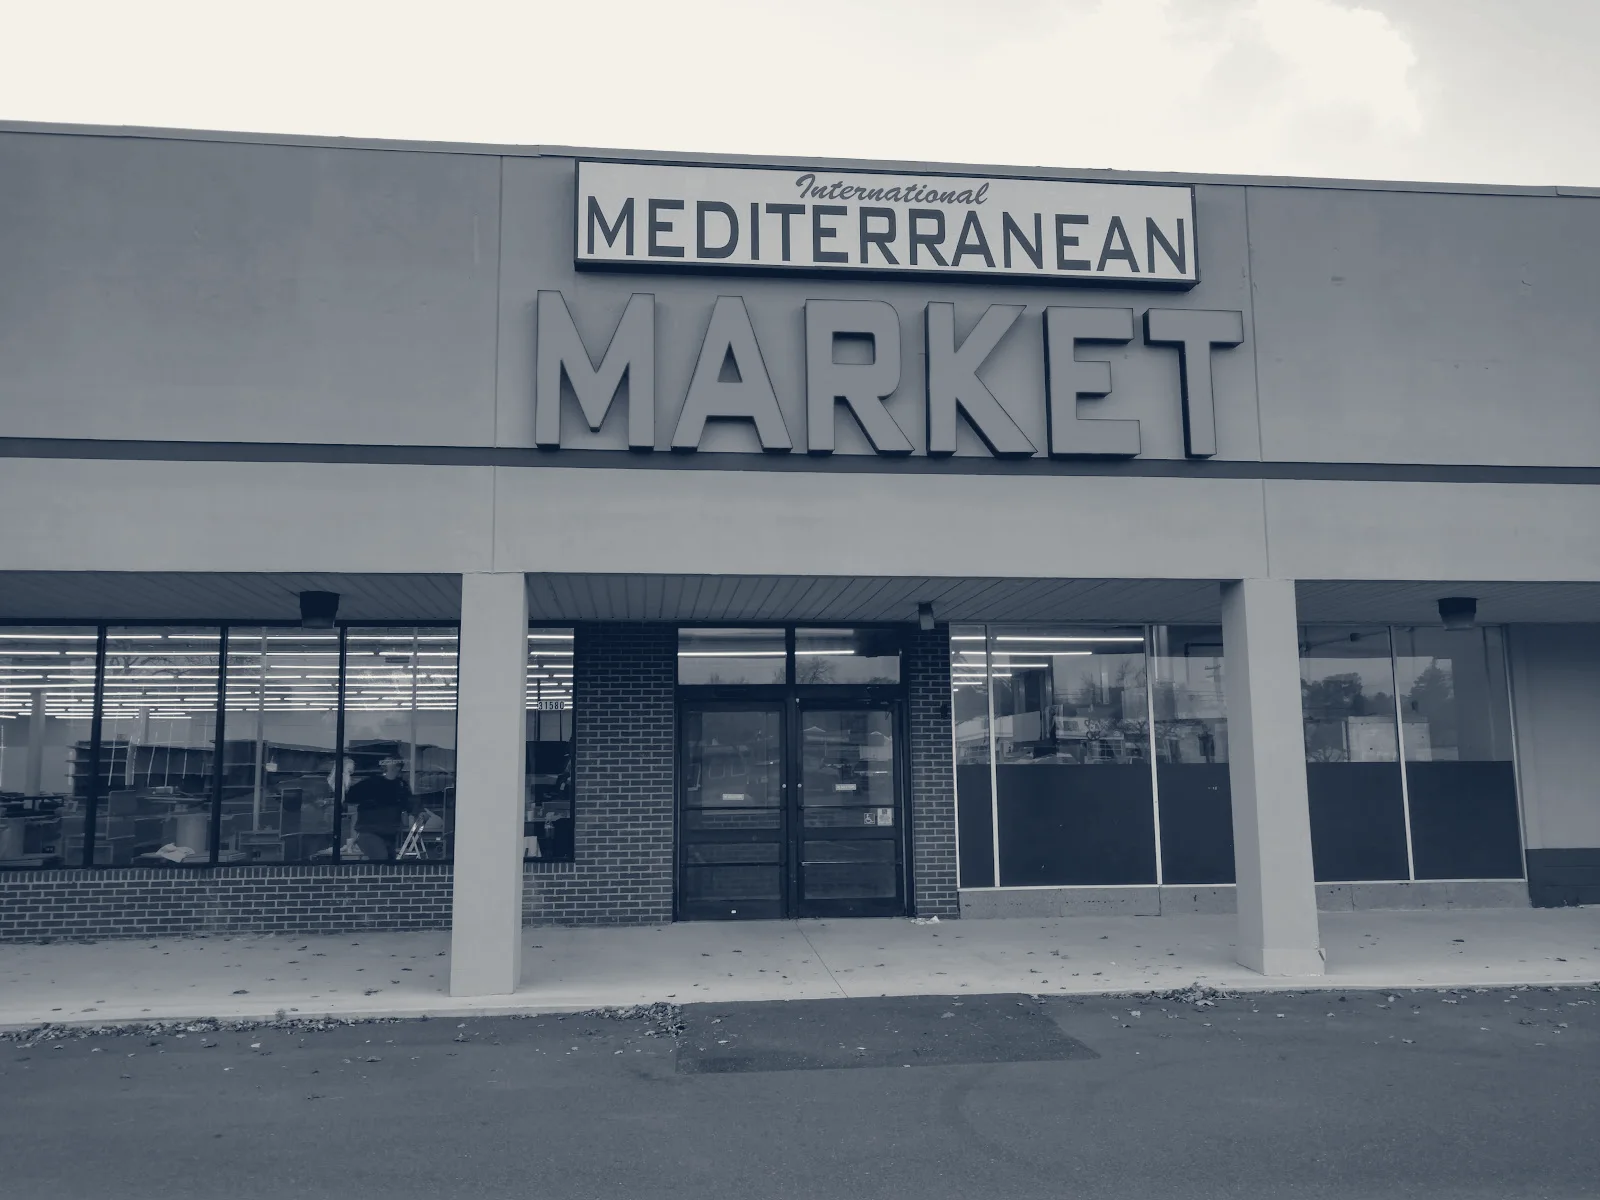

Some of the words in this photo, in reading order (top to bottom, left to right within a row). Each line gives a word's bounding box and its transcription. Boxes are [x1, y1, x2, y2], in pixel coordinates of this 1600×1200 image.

[795, 172, 989, 205] International
[586, 195, 1187, 275] MEDITERRANEAN
[535, 290, 1245, 456] MARKET
[538, 701, 565, 710] 31580
